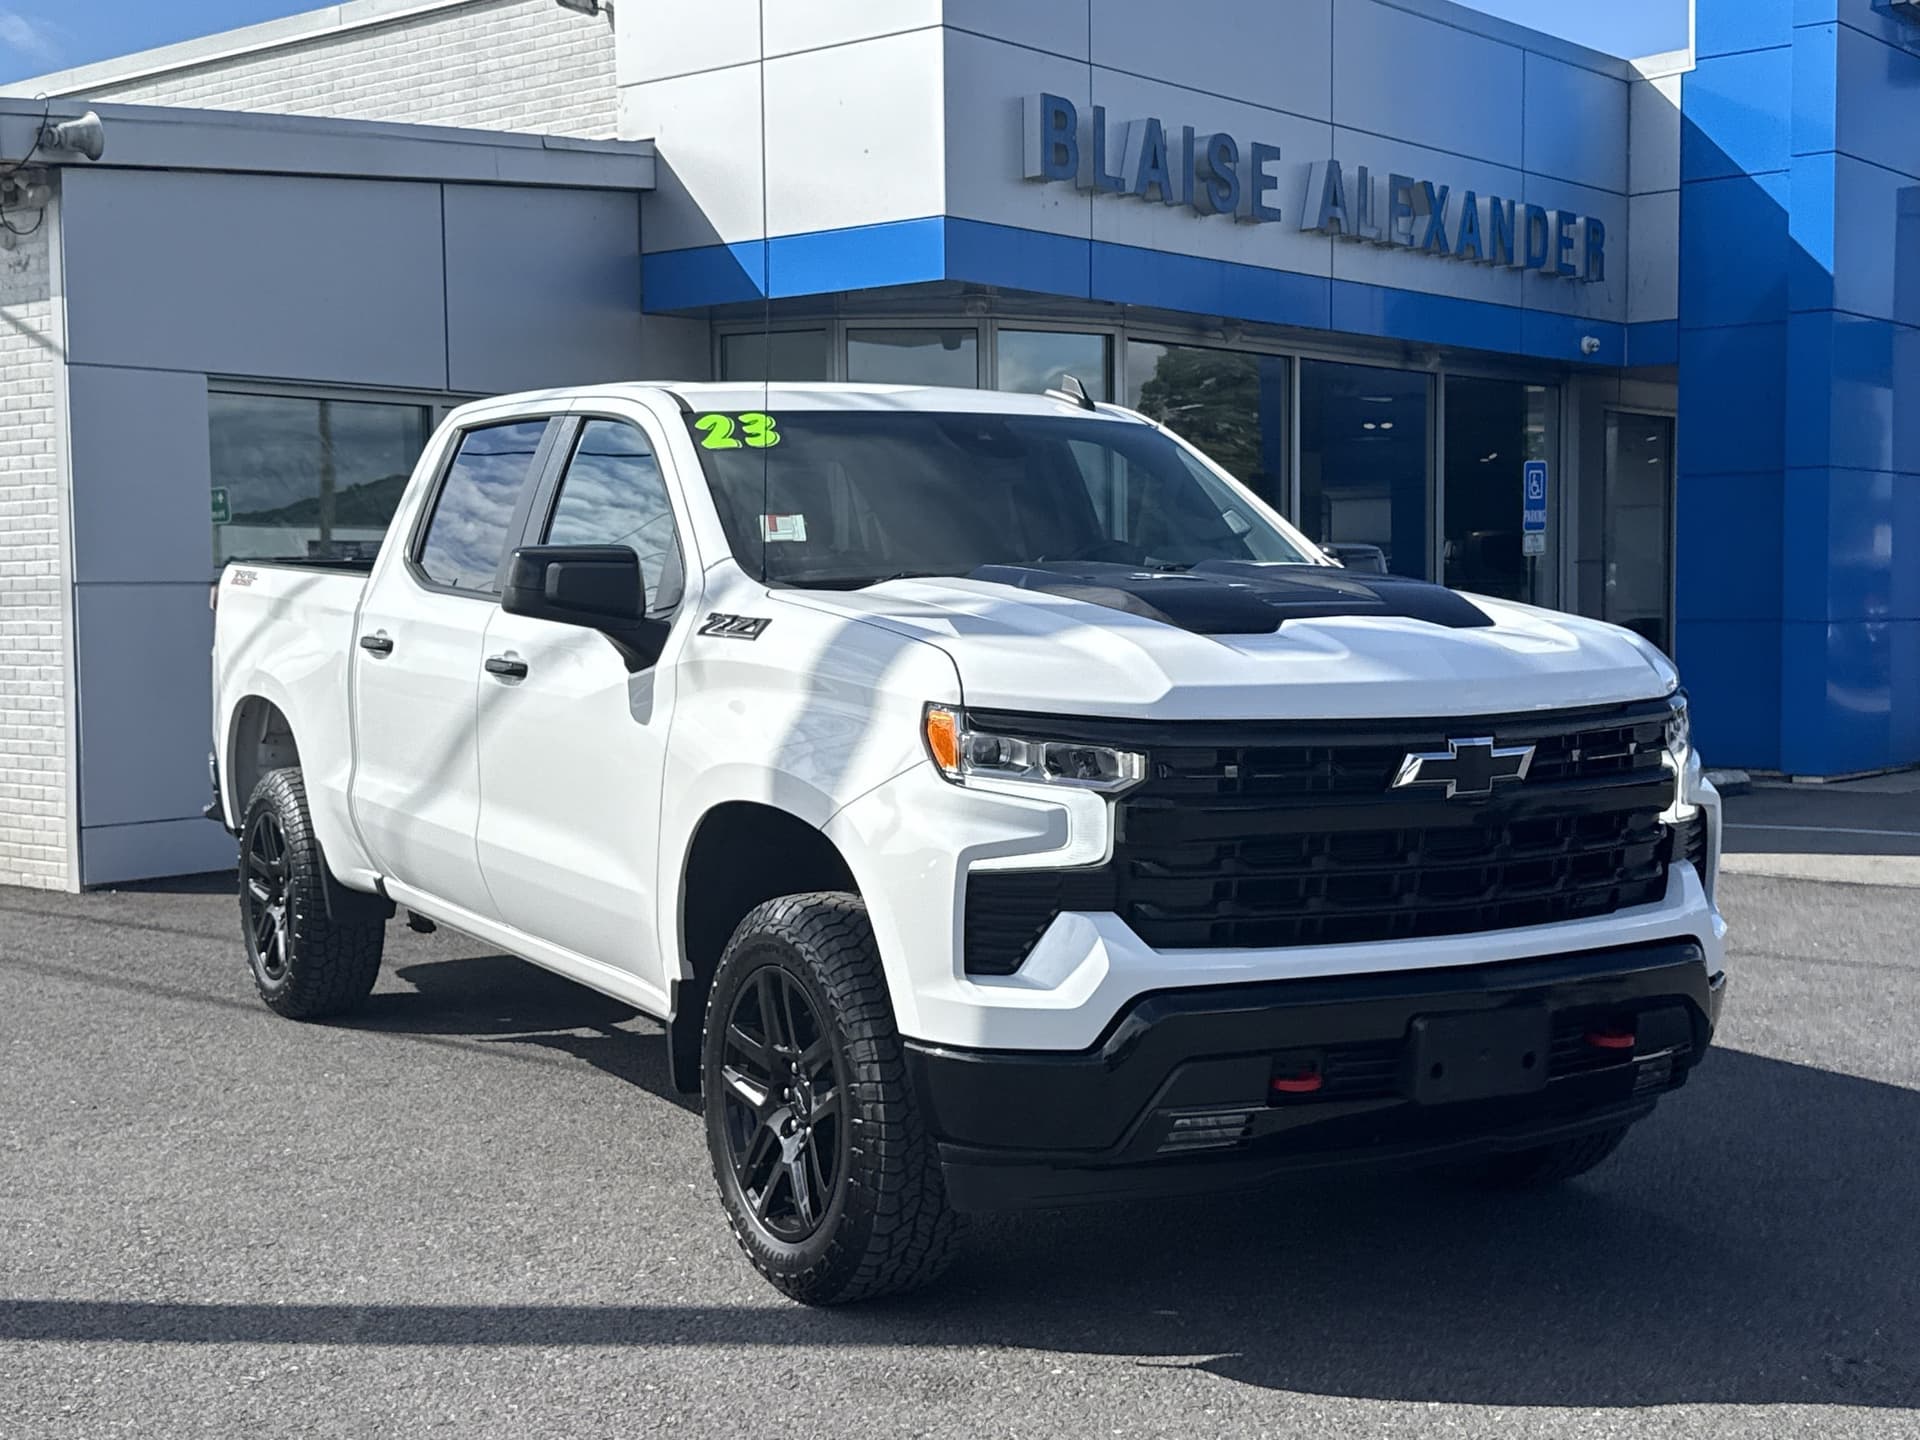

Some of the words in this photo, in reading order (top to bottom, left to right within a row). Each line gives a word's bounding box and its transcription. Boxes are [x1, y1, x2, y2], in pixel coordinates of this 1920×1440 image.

[1041, 92, 1281, 223] BLAISE
[1314, 159, 1605, 283] ALEXANDER
[694, 413, 780, 449] 23
[697, 612, 773, 641] Z71
